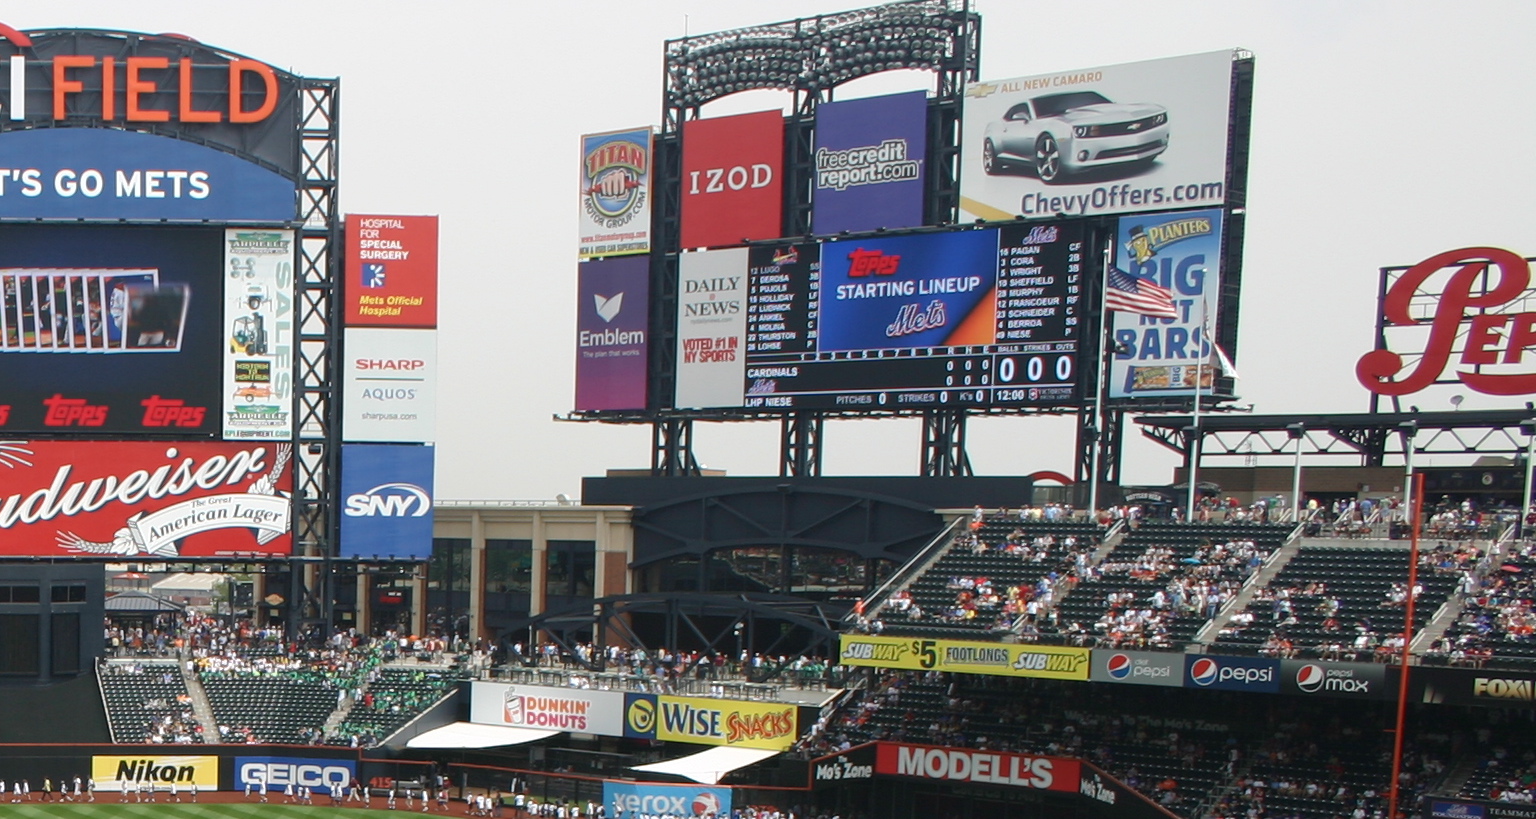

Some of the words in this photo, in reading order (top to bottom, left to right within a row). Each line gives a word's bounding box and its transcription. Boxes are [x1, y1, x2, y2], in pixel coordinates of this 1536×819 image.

[52, 56, 279, 123] FIELD
[1001, 81, 1022, 93] ALL
[1024, 77, 1052, 91] NEW
[1053, 72, 1103, 88] CAMARO
[588, 145, 645, 174] TITAN
[818, 142, 904, 169] freecredit
[54, 169, 103, 197] GO
[116, 170, 211, 199] METS
[689, 164, 772, 194] IZOD
[819, 163, 917, 189] report.com
[1021, 181, 1223, 214] ChevyOffers.com
[360, 219, 405, 229] HOSPITAL
[1149, 218, 1210, 246] PLANTERS
[360, 229, 380, 239] FOR
[359, 240, 403, 250] SPECIAL
[359, 250, 409, 260] SURGERY
[1010, 257, 1035, 267] CORA
[1008, 276, 1054, 287] SHEFFIELD
[1128, 254, 1207, 297] BIG
[685, 276, 741, 294] DAILY
[836, 282, 914, 299] STARTING
[919, 276, 981, 294] LINEUP
[359, 295, 384, 305] Mets
[386, 296, 423, 306] Official
[684, 301, 740, 317] NEWS
[1008, 297, 1060, 308] FRANCOEUR
[359, 306, 402, 318] Hospital
[885, 300, 947, 338] Mets
[1007, 307, 1056, 318] SCHNEIDER
[275, 261, 292, 400] SALES
[580, 328, 644, 347] Emblem
[683, 338, 713, 351] VOTED
[714, 337, 726, 350] #1
[727, 336, 739, 349] IN
[1023, 344, 1051, 352] STRIKES
[1055, 343, 1075, 351] OUTS
[1114, 326, 1211, 361] BARS
[355, 358, 425, 371] SHARP
[684, 351, 697, 363] NY
[698, 349, 736, 363] SPORTS
[747, 367, 798, 379] CARDINALS
[999, 357, 1015, 382] 0
[1027, 357, 1043, 382] 0
[1055, 355, 1072, 381] 0
[362, 388, 416, 402] AQUOS
[745, 397, 763, 407] LHP
[765, 397, 794, 407] NIESE
[836, 395, 872, 405] PITCHES
[898, 393, 935, 403] STRIKES
[996, 389, 1025, 400] 12:00
[362, 412, 418, 422] sharpusa.com
[345, 493, 418, 517] SNY
[149, 504, 229, 544] American
[233, 504, 282, 525] Lager
[842, 642, 910, 662] SUBWAY
[911, 640, 936, 669] $5
[946, 647, 1008, 663] FOOTLONGS
[1013, 652, 1088, 672] SUBWAY
[1133, 666, 1171, 679] pepsi
[1219, 666, 1273, 684] pepsi
[1326, 669, 1353, 679] pepsi
[1325, 677, 1368, 693] max
[526, 697, 591, 715] DUNKIN'
[526, 711, 587, 730] DONUTS
[661, 701, 724, 736] WISE
[727, 708, 794, 744] SNACKS
[115, 760, 195, 784] Nikon
[240, 762, 350, 788] GEICO
[816, 763, 841, 780] Mo's
[843, 762, 872, 779] Zone
[897, 747, 1053, 790] MODELL'S
[369, 776, 391, 788] 415
[614, 791, 687, 815] xerox
